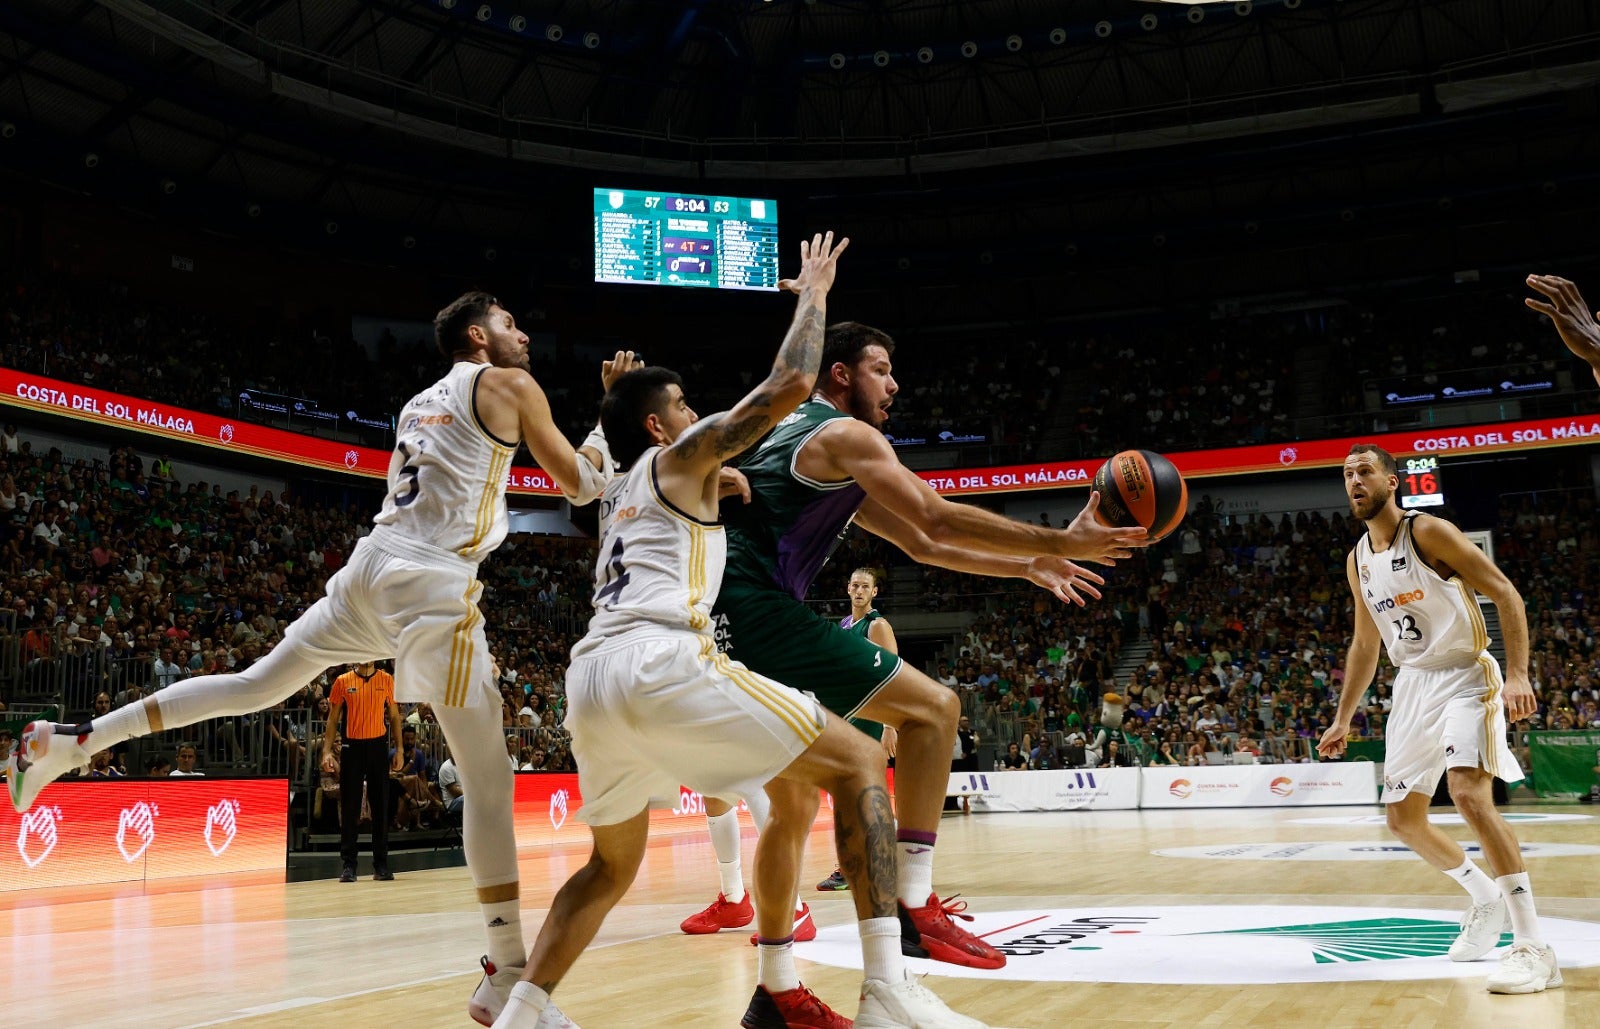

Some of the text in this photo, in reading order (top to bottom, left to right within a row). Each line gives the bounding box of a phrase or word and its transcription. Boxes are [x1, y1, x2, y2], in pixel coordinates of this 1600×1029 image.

[644, 196, 729, 213] 57 9:04 53
[680, 241, 695, 252] 4T
[670, 259, 680, 271] 0
[699, 261, 706, 273] 1
[16, 382, 195, 434] COSTA DEL SOL MÁLAGA
[1413, 422, 1600, 452] COSTA DEL SOL MÁLA
[1406, 457, 1437, 470] 9:04
[523, 475, 549, 488] SOL
[923, 468, 1088, 490] STA DEL SOL MÁLAGA
[1405, 473, 1437, 495] 16
[714, 627, 732, 641] OL
[673, 791, 706, 815] OST
